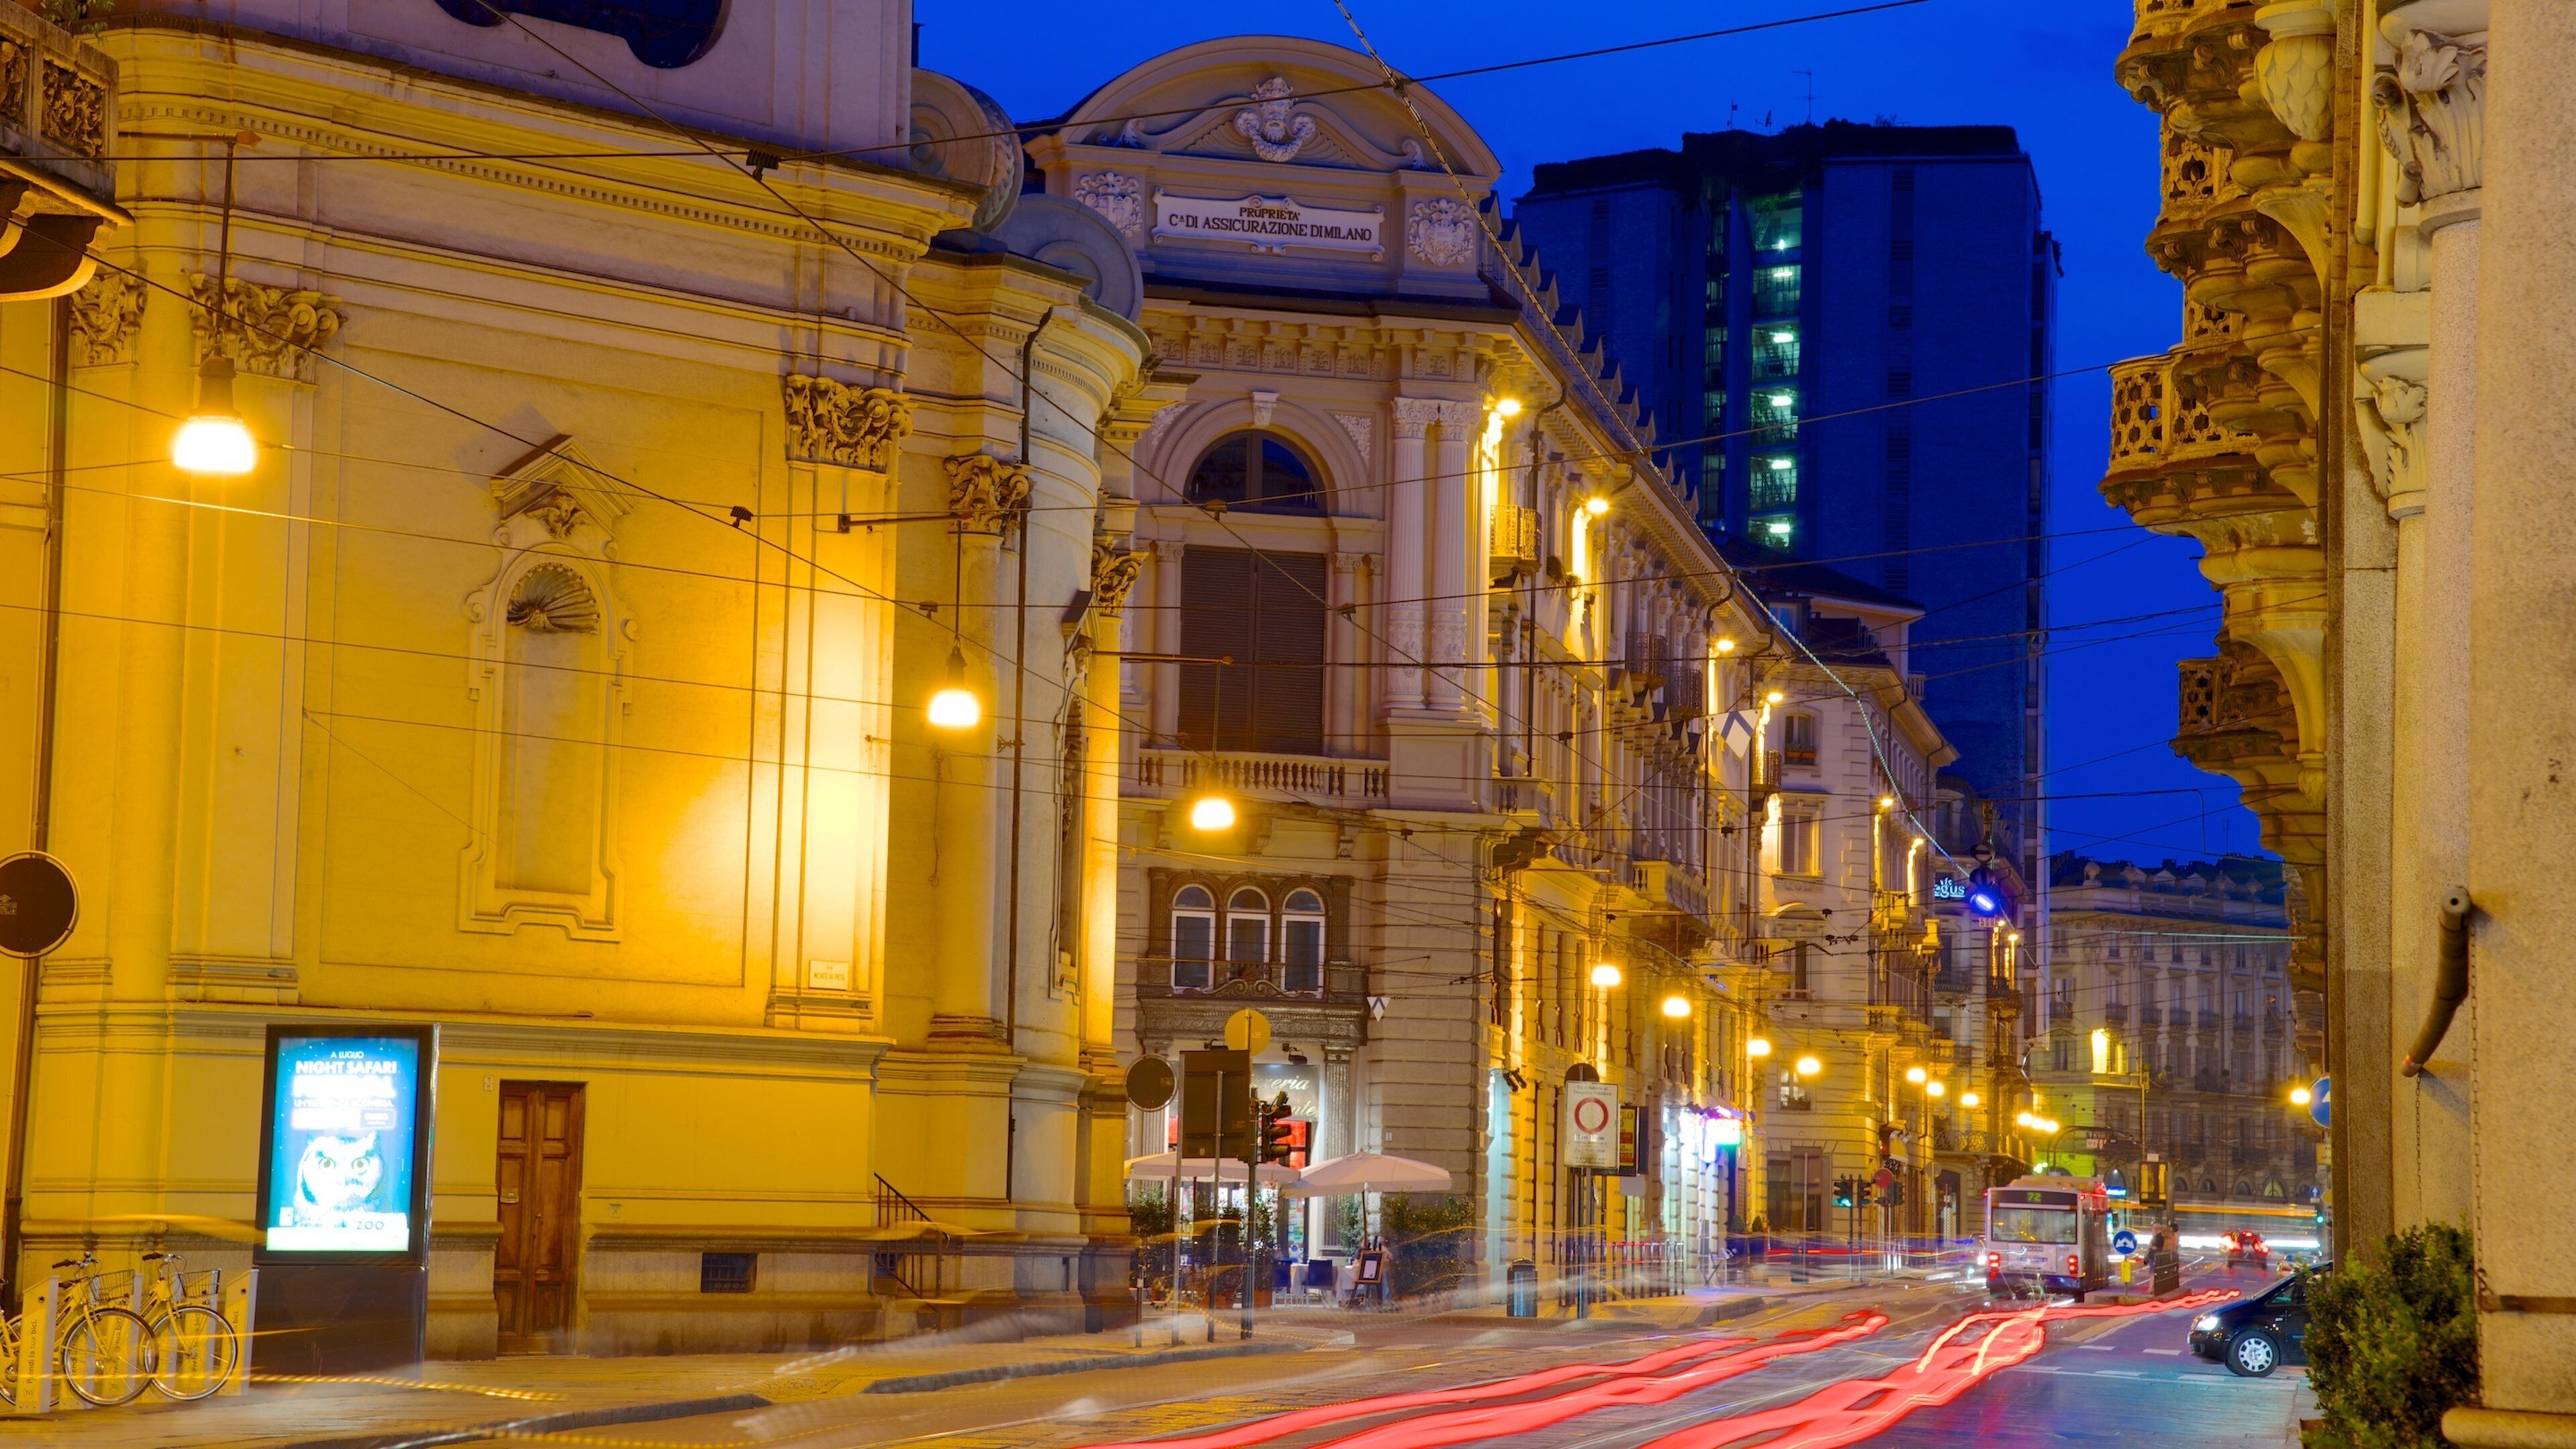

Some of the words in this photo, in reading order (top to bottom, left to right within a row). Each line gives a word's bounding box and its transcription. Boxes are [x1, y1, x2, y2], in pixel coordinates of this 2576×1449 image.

[1185, 215, 1198, 229] DI
[1203, 217, 1307, 237] ASSICURAZIONE
[1310, 225, 1323, 237] DI
[1324, 225, 1372, 241] MILANO
[1934, 883, 1966, 898] egus
[295, 1061, 345, 1074] NIGHT
[346, 1061, 398, 1074] SAFARI
[2027, 1192, 2042, 1202] 72
[356, 1220, 384, 1230] ZOO
